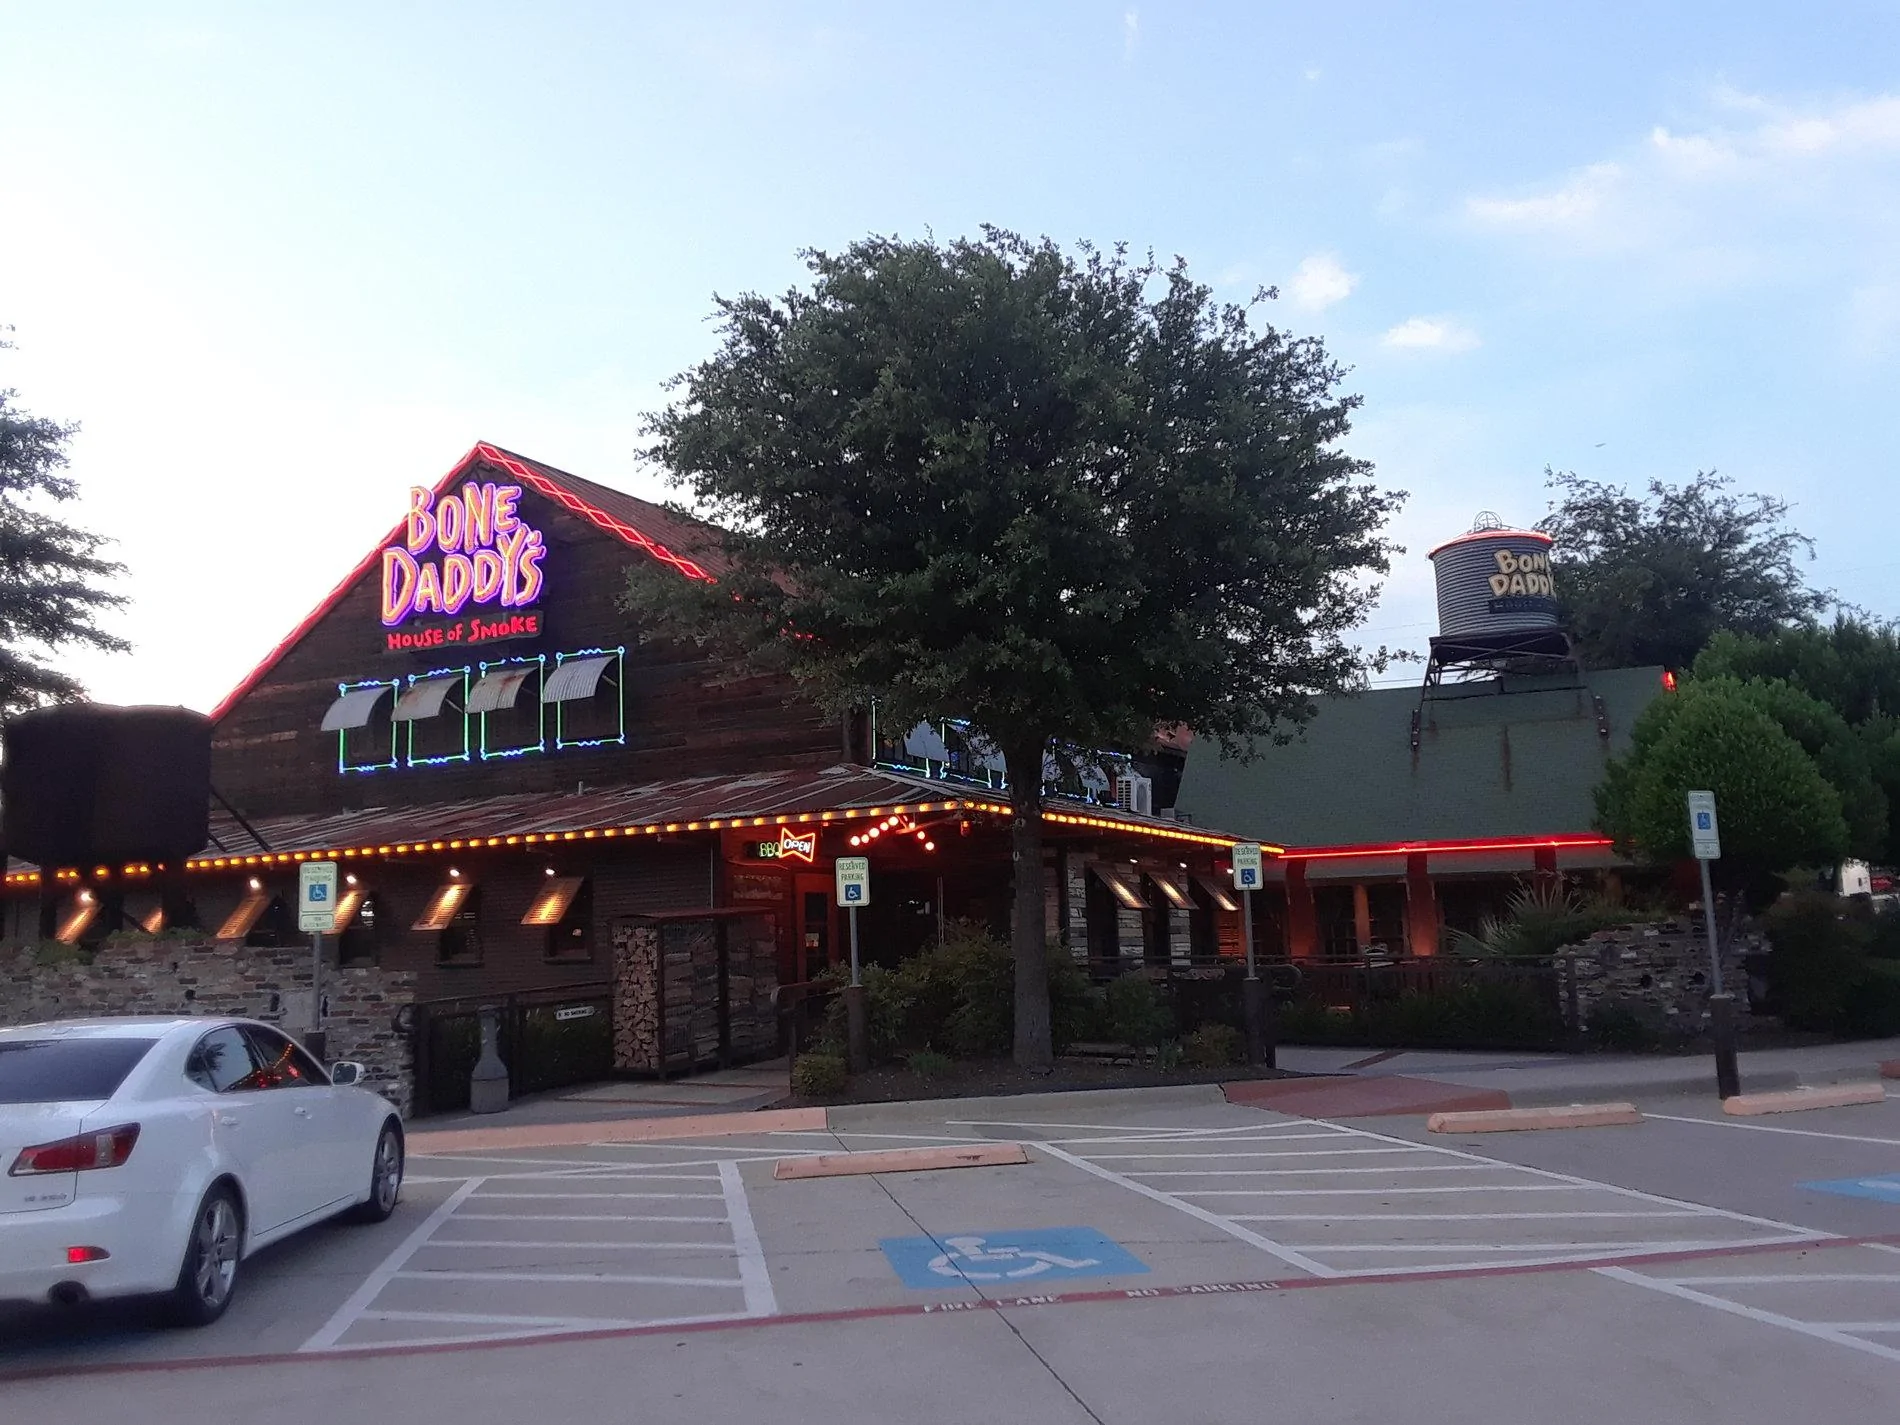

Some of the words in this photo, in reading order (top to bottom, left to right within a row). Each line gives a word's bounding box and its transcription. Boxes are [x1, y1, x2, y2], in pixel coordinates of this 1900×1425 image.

[408, 482, 522, 556] BONE
[382, 523, 547, 626] DADDY'S
[387, 628, 444, 650] HOUSE
[468, 616, 538, 643] SMOKE
[760, 842, 781, 857] BBQ
[783, 838, 812, 853] OPEN
[839, 862, 866, 870] RESERVED
[841, 873, 864, 881] PARKING
[1126, 1289, 1160, 1298] NO
